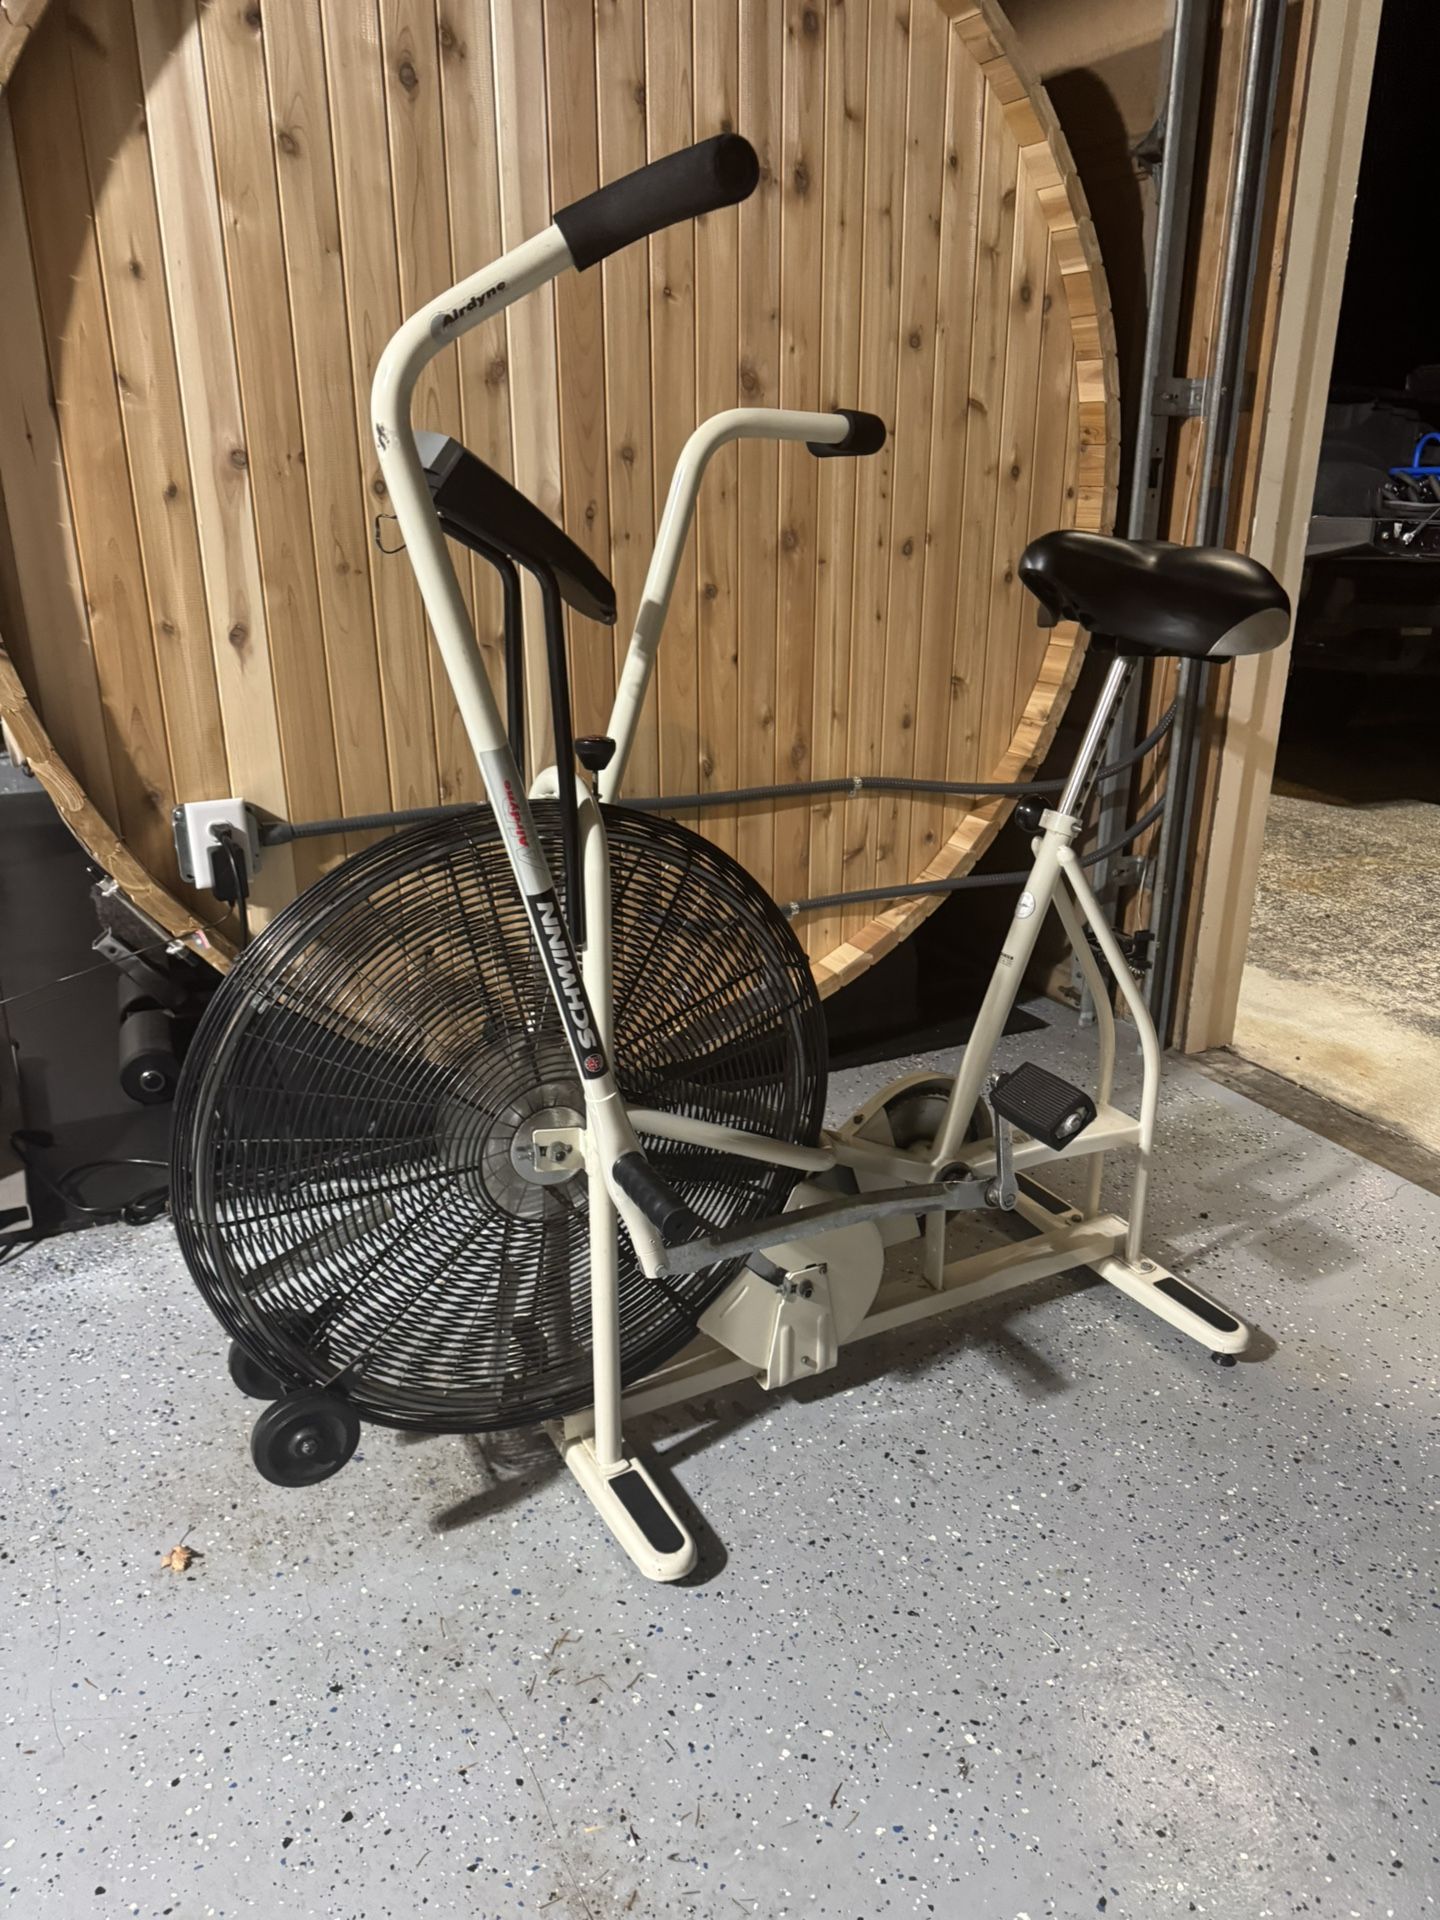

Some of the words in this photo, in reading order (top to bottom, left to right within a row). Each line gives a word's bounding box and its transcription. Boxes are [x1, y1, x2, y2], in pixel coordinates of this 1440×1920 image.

[442, 281, 506, 328] Airdyne
[504, 780, 529, 848] Airdyne
[536, 902, 597, 1049] SCHWINN
